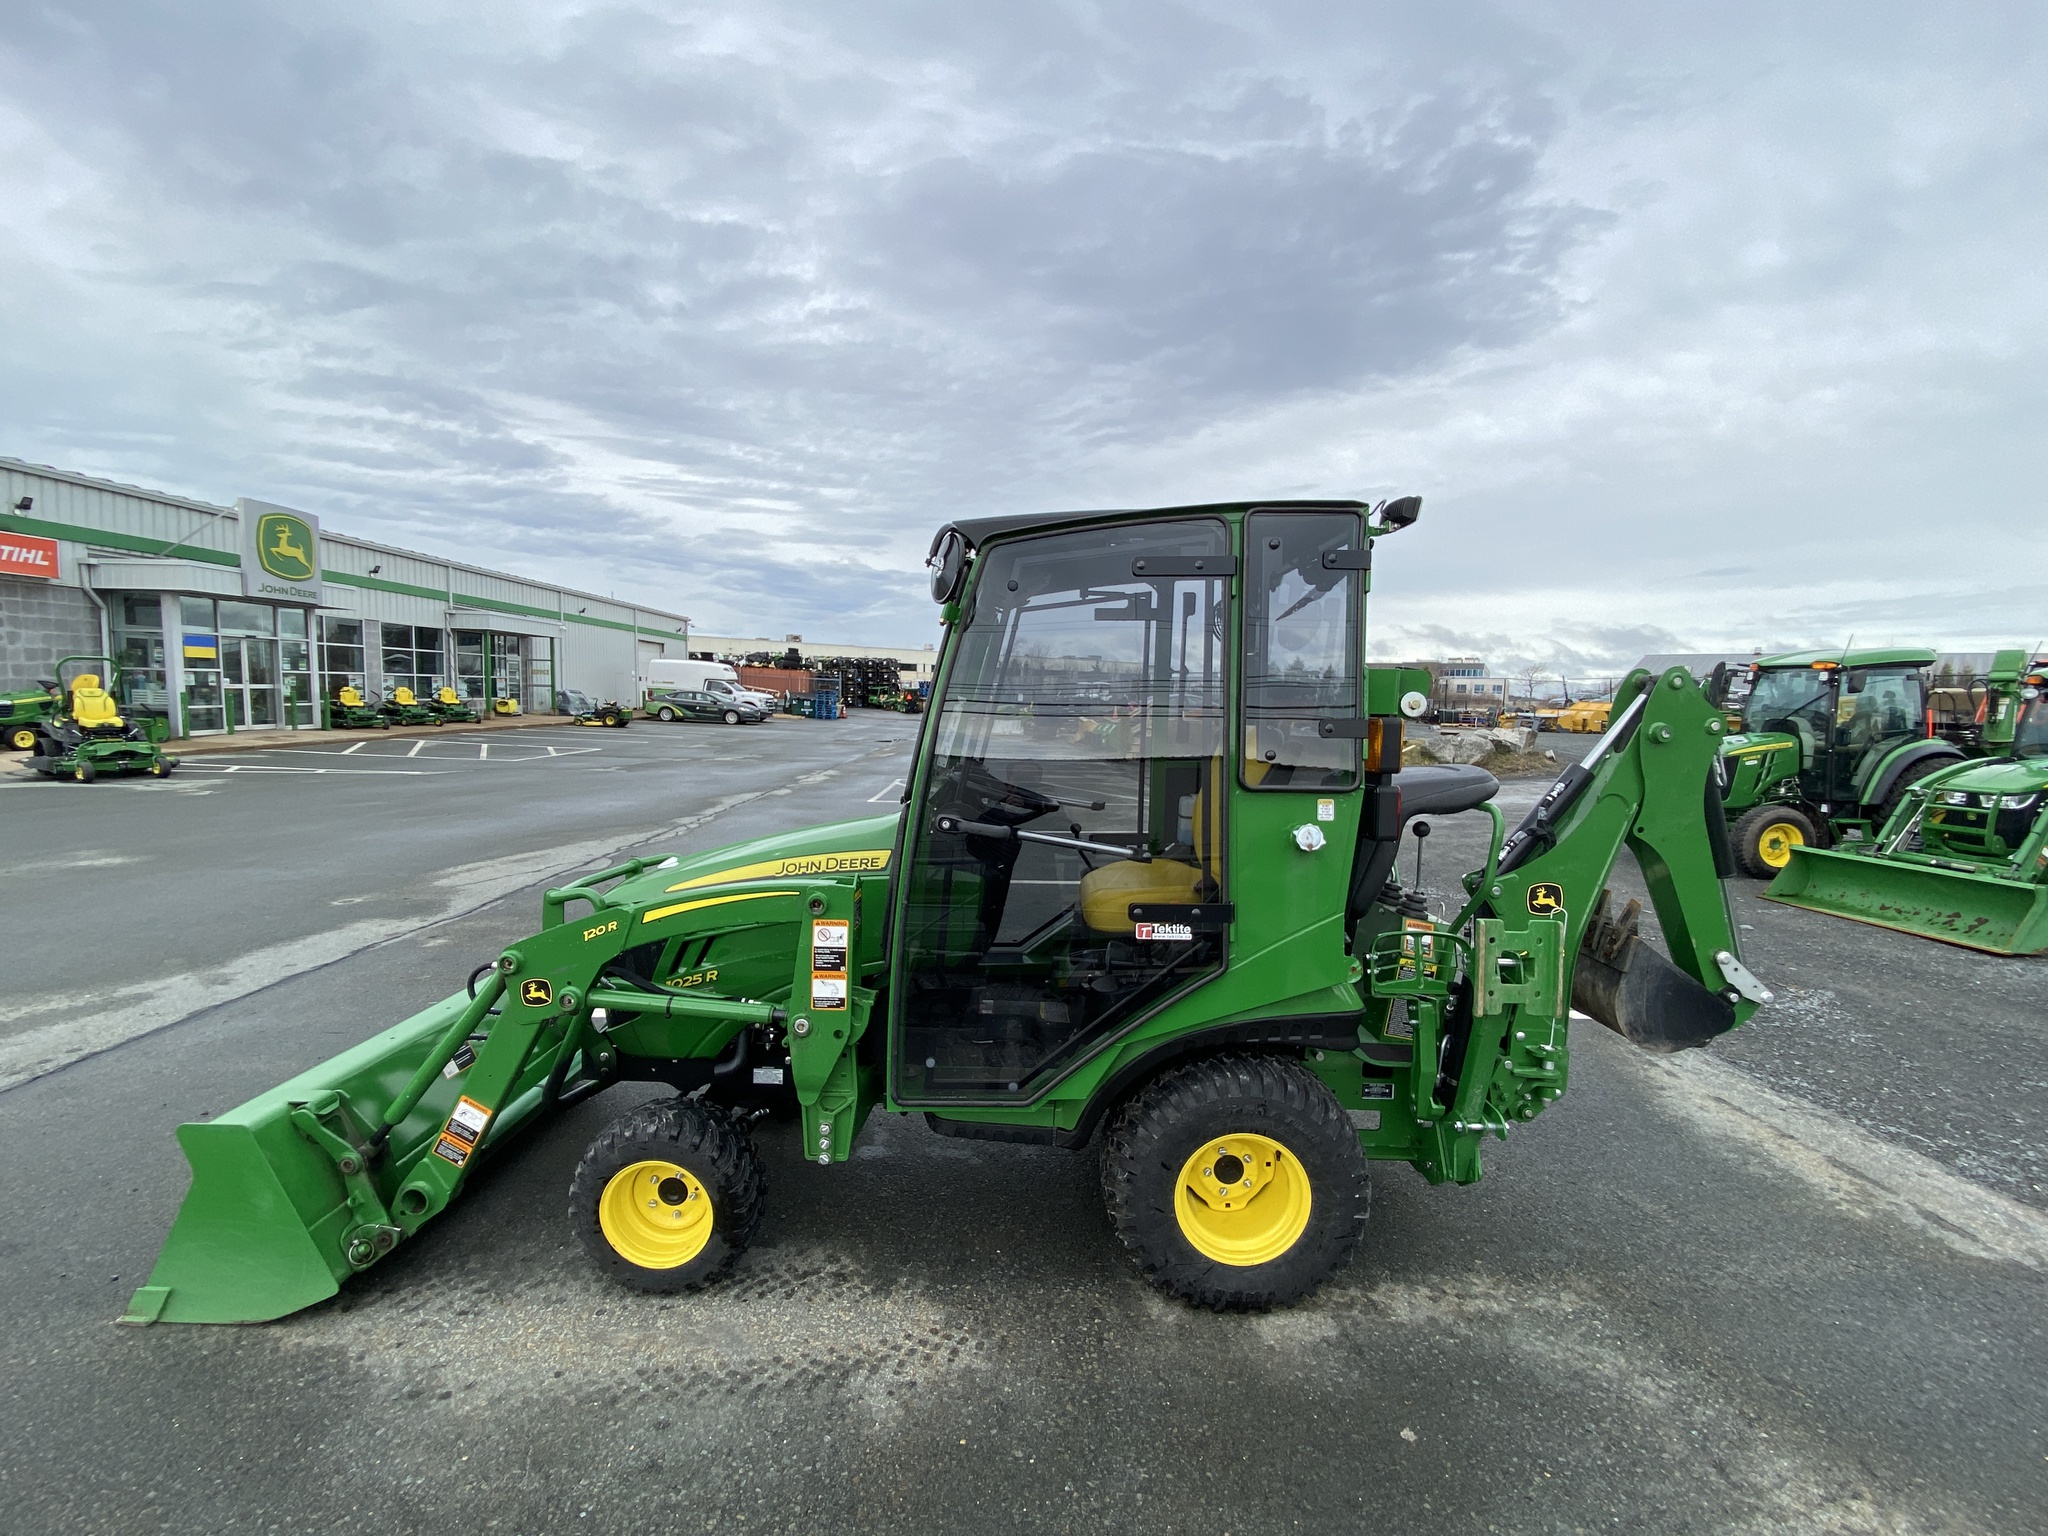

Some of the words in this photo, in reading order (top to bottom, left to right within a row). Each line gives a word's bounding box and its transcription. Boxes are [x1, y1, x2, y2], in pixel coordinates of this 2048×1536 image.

[0, 545, 49, 566] TIHL
[258, 583, 289, 595] JOHN
[290, 587, 318, 599] DEERE
[775, 860, 821, 875] JOHN
[826, 857, 881, 870] DEERE
[583, 925, 606, 942] 120
[608, 921, 618, 932] R
[1152, 923, 1191, 934] Tektite
[706, 970, 718, 982] R
